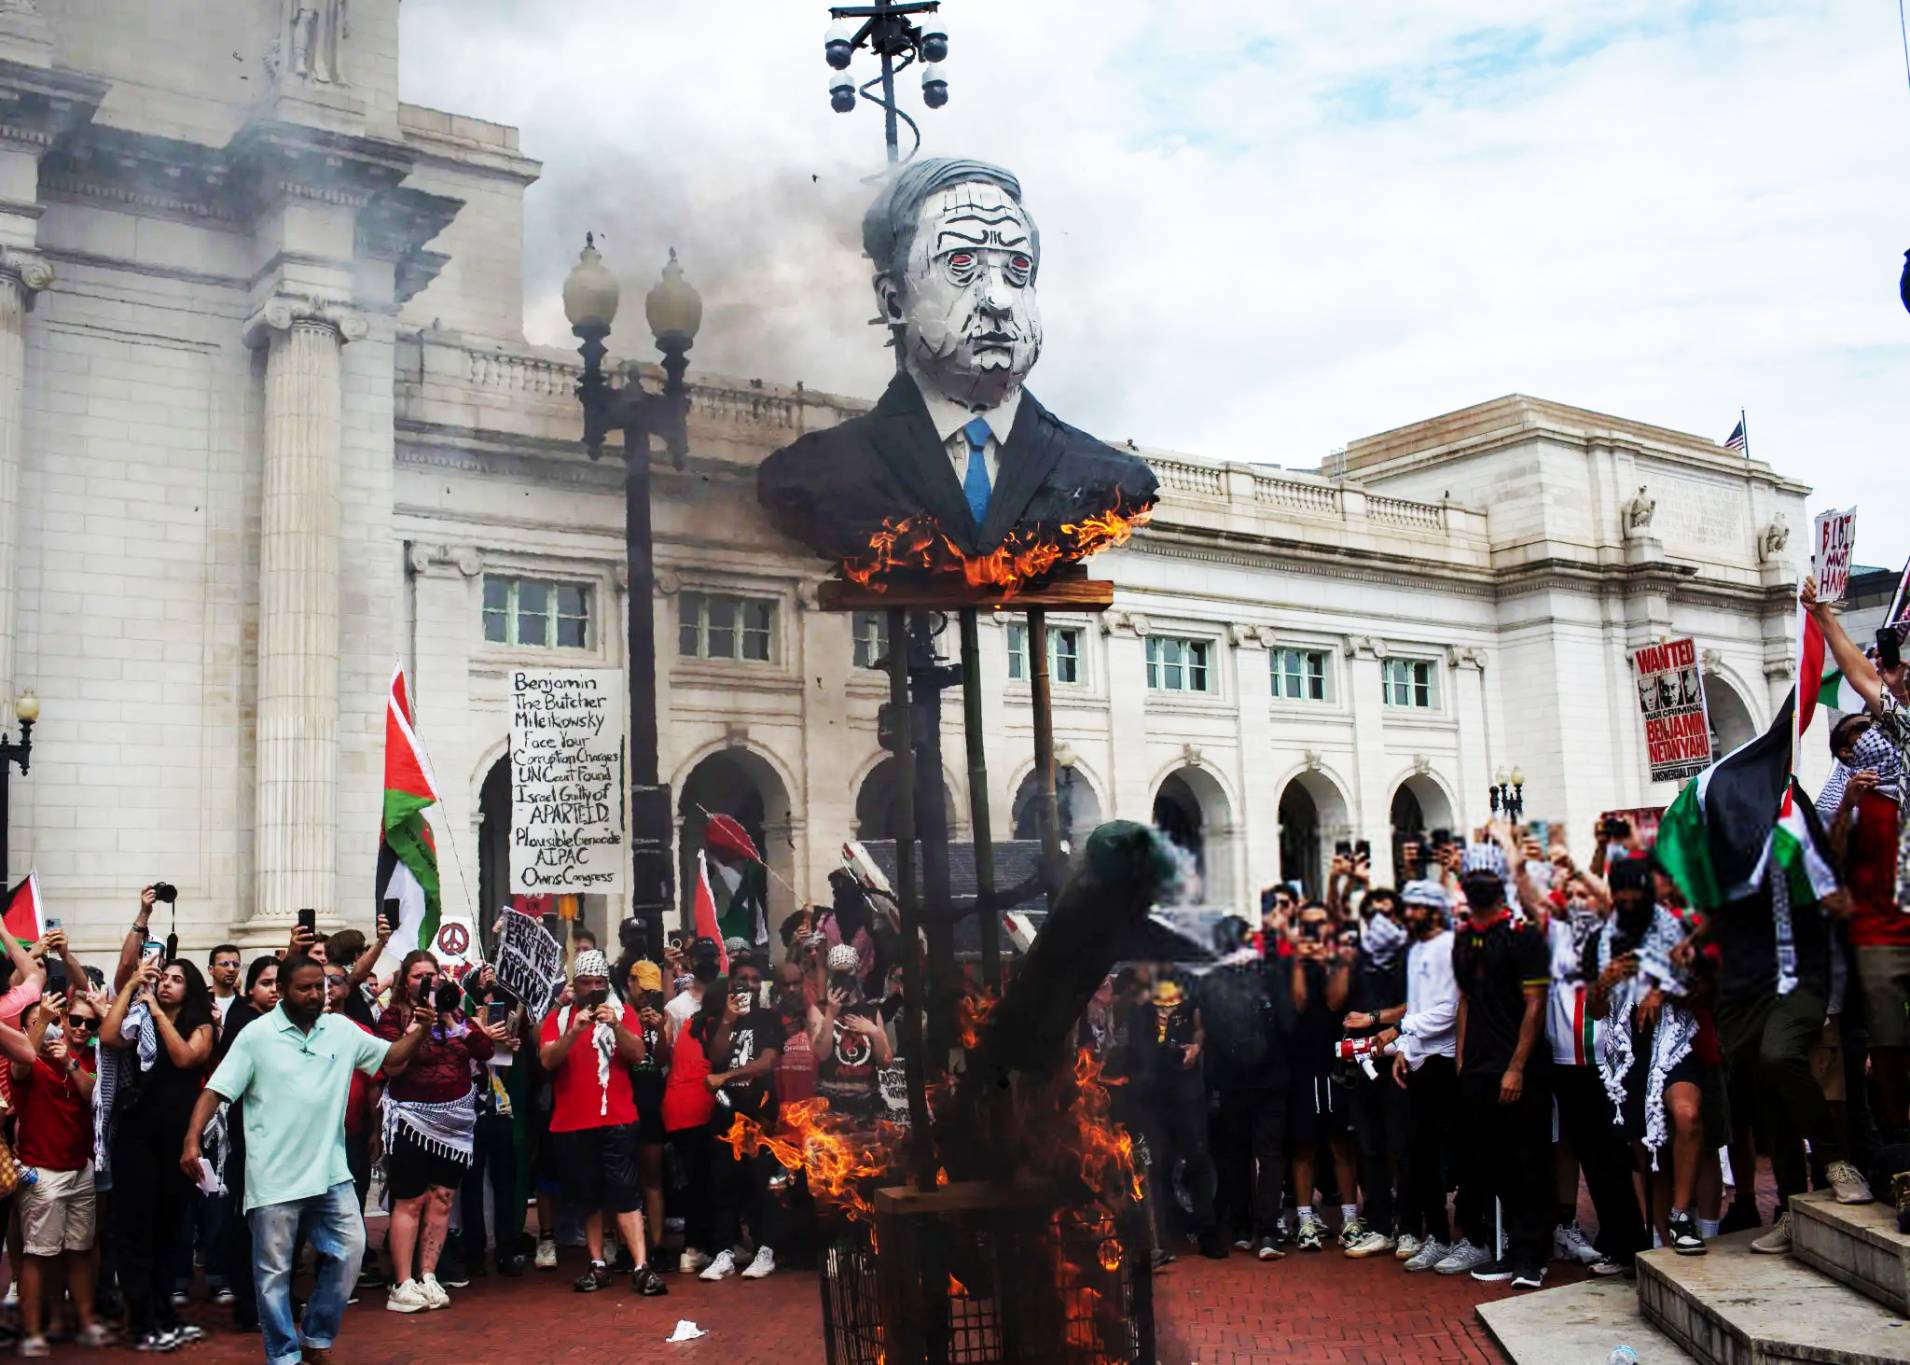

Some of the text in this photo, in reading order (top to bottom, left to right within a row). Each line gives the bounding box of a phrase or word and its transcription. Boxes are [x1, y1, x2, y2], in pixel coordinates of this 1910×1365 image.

[1826, 550, 1848, 568] MUST
[1636, 639, 1695, 674] WANTED
[514, 672, 597, 694] Benjamin
[511, 692, 607, 710] The Butcher
[1645, 704, 1703, 720] WAR CRIMINAL
[1646, 712, 1706, 743] BENJAMIN
[524, 730, 590, 748] Face Your
[1649, 734, 1709, 763] NETANYAHU
[576, 747, 618, 767] Charges
[519, 766, 611, 783] UN Court Found
[515, 784, 557, 803] Israel
[592, 782, 612, 800] of
[516, 827, 573, 847] Plausible
[534, 847, 589, 866] AIPAC
[521, 865, 615, 887] Owns Congress
[506, 931, 556, 984] END THE
